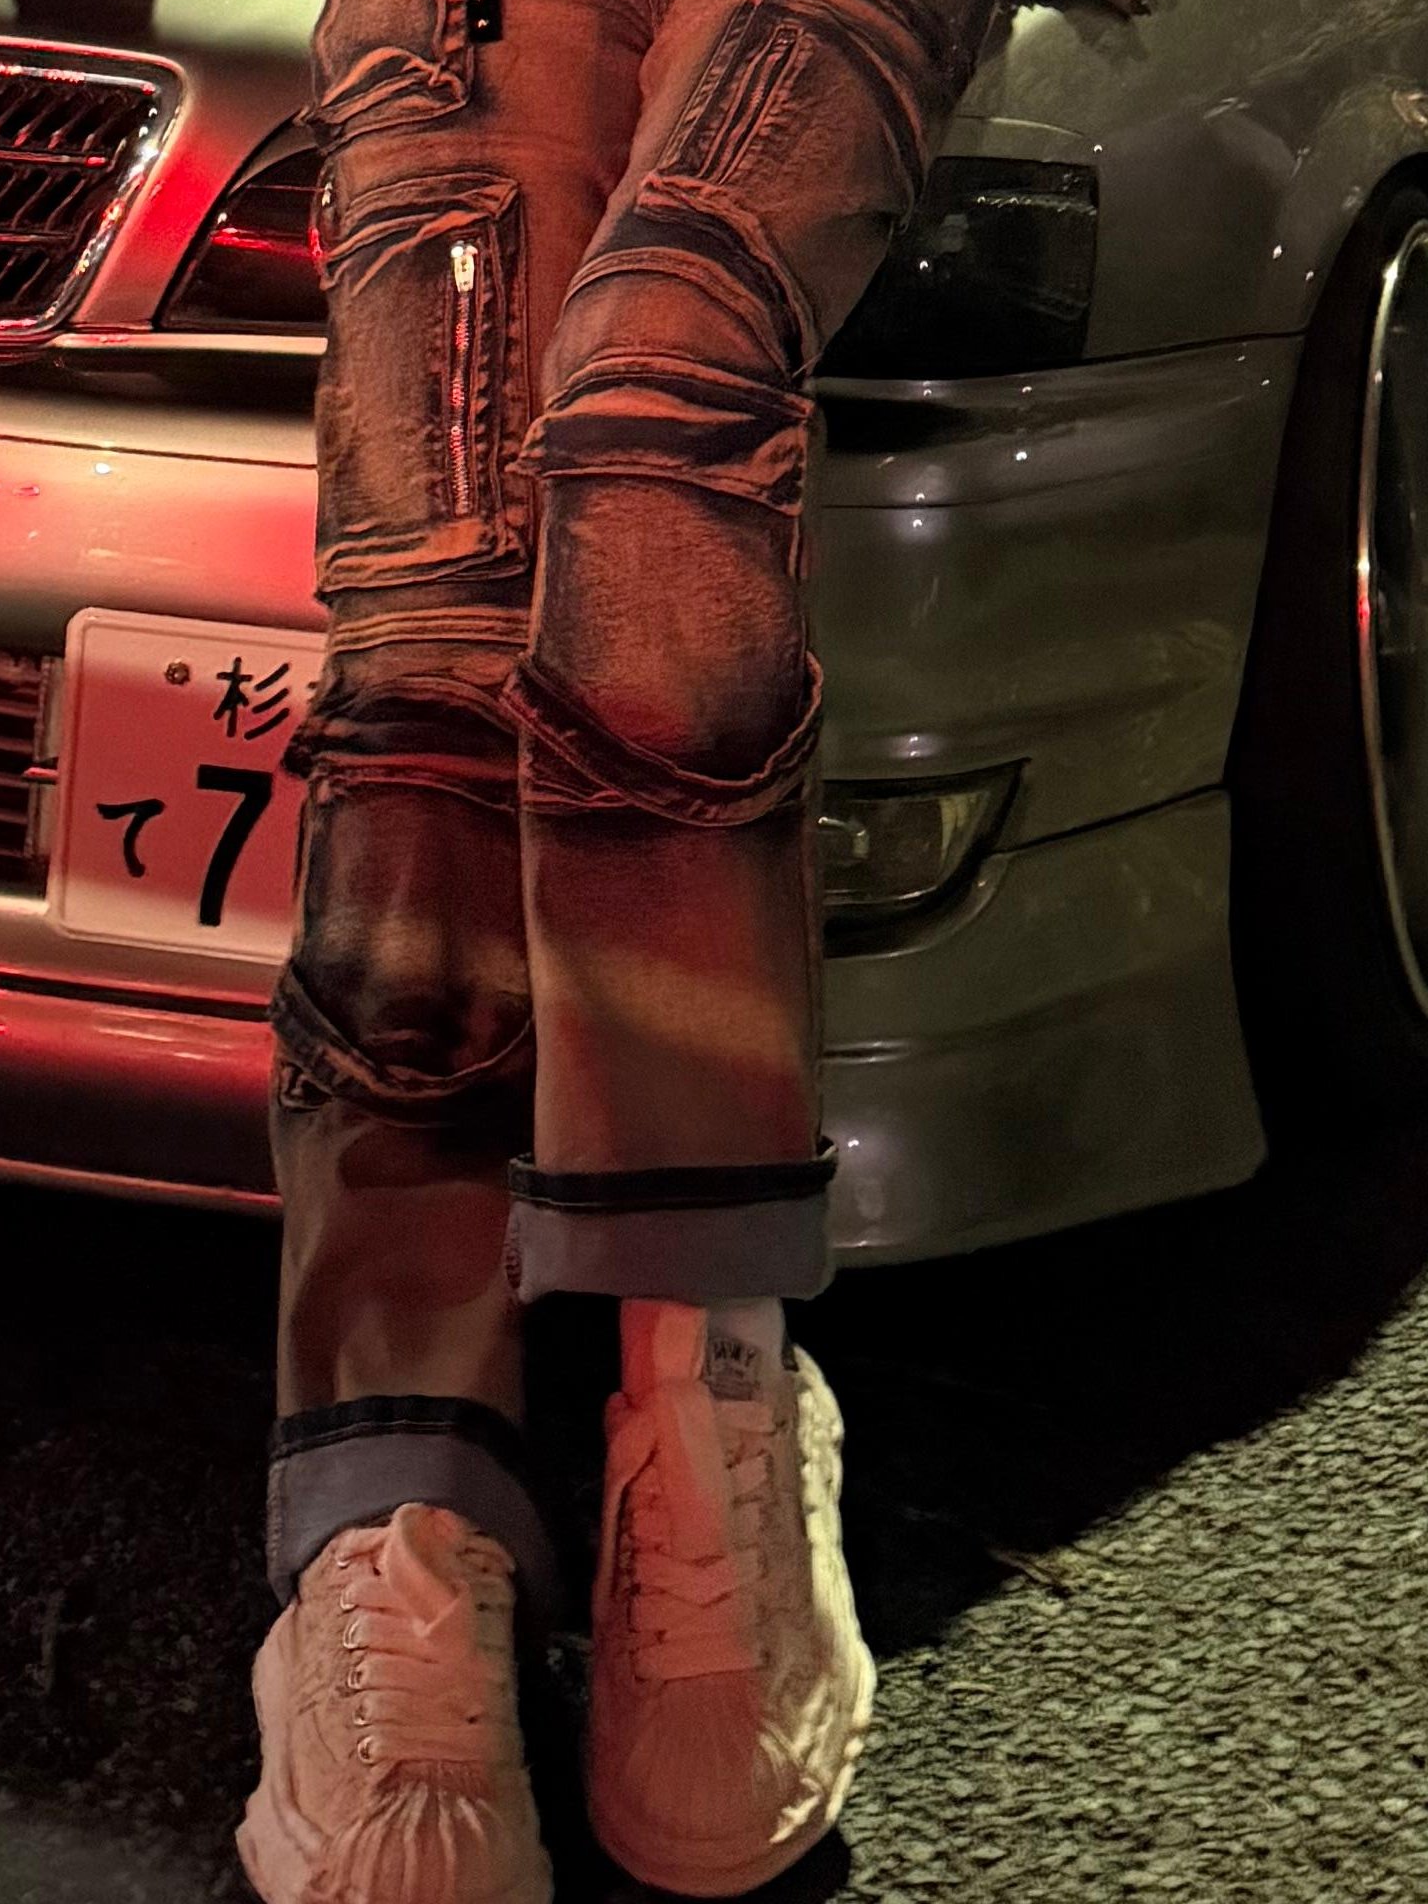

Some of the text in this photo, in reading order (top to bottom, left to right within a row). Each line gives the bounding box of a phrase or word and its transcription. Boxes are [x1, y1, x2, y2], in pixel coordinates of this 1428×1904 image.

[213, 656, 317, 741] 杉
[95, 763, 273, 928] て 7
